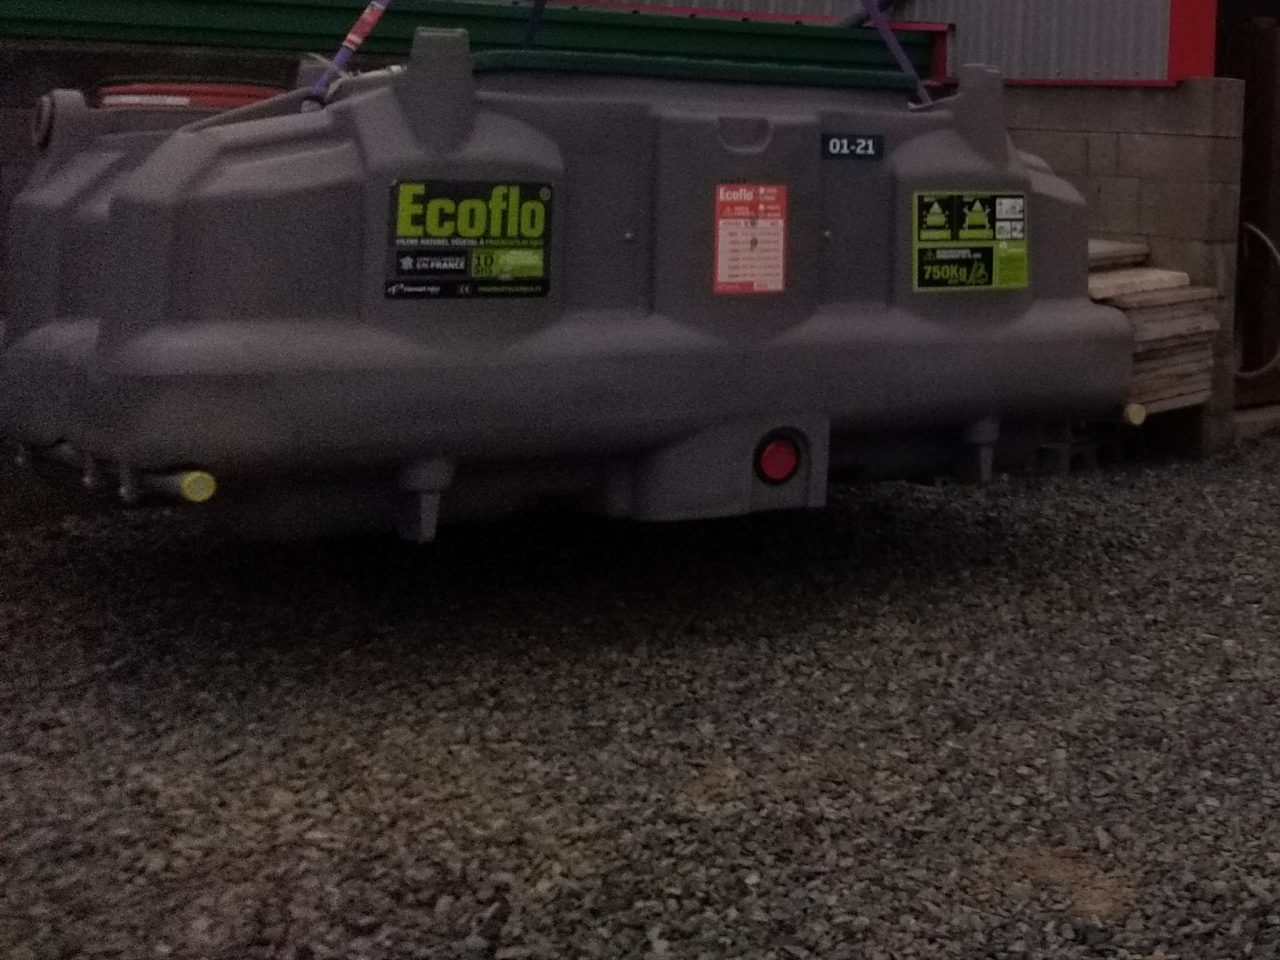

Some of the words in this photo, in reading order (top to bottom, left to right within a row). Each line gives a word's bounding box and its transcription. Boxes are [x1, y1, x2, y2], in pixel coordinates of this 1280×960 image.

[829, 138, 875, 155] 01-21
[719, 187, 753, 202] Ecoflo
[396, 182, 546, 238] Ecoflo
[430, 261, 466, 271] FRANCE
[476, 254, 495, 267] 10
[923, 264, 967, 282] 750Kg
